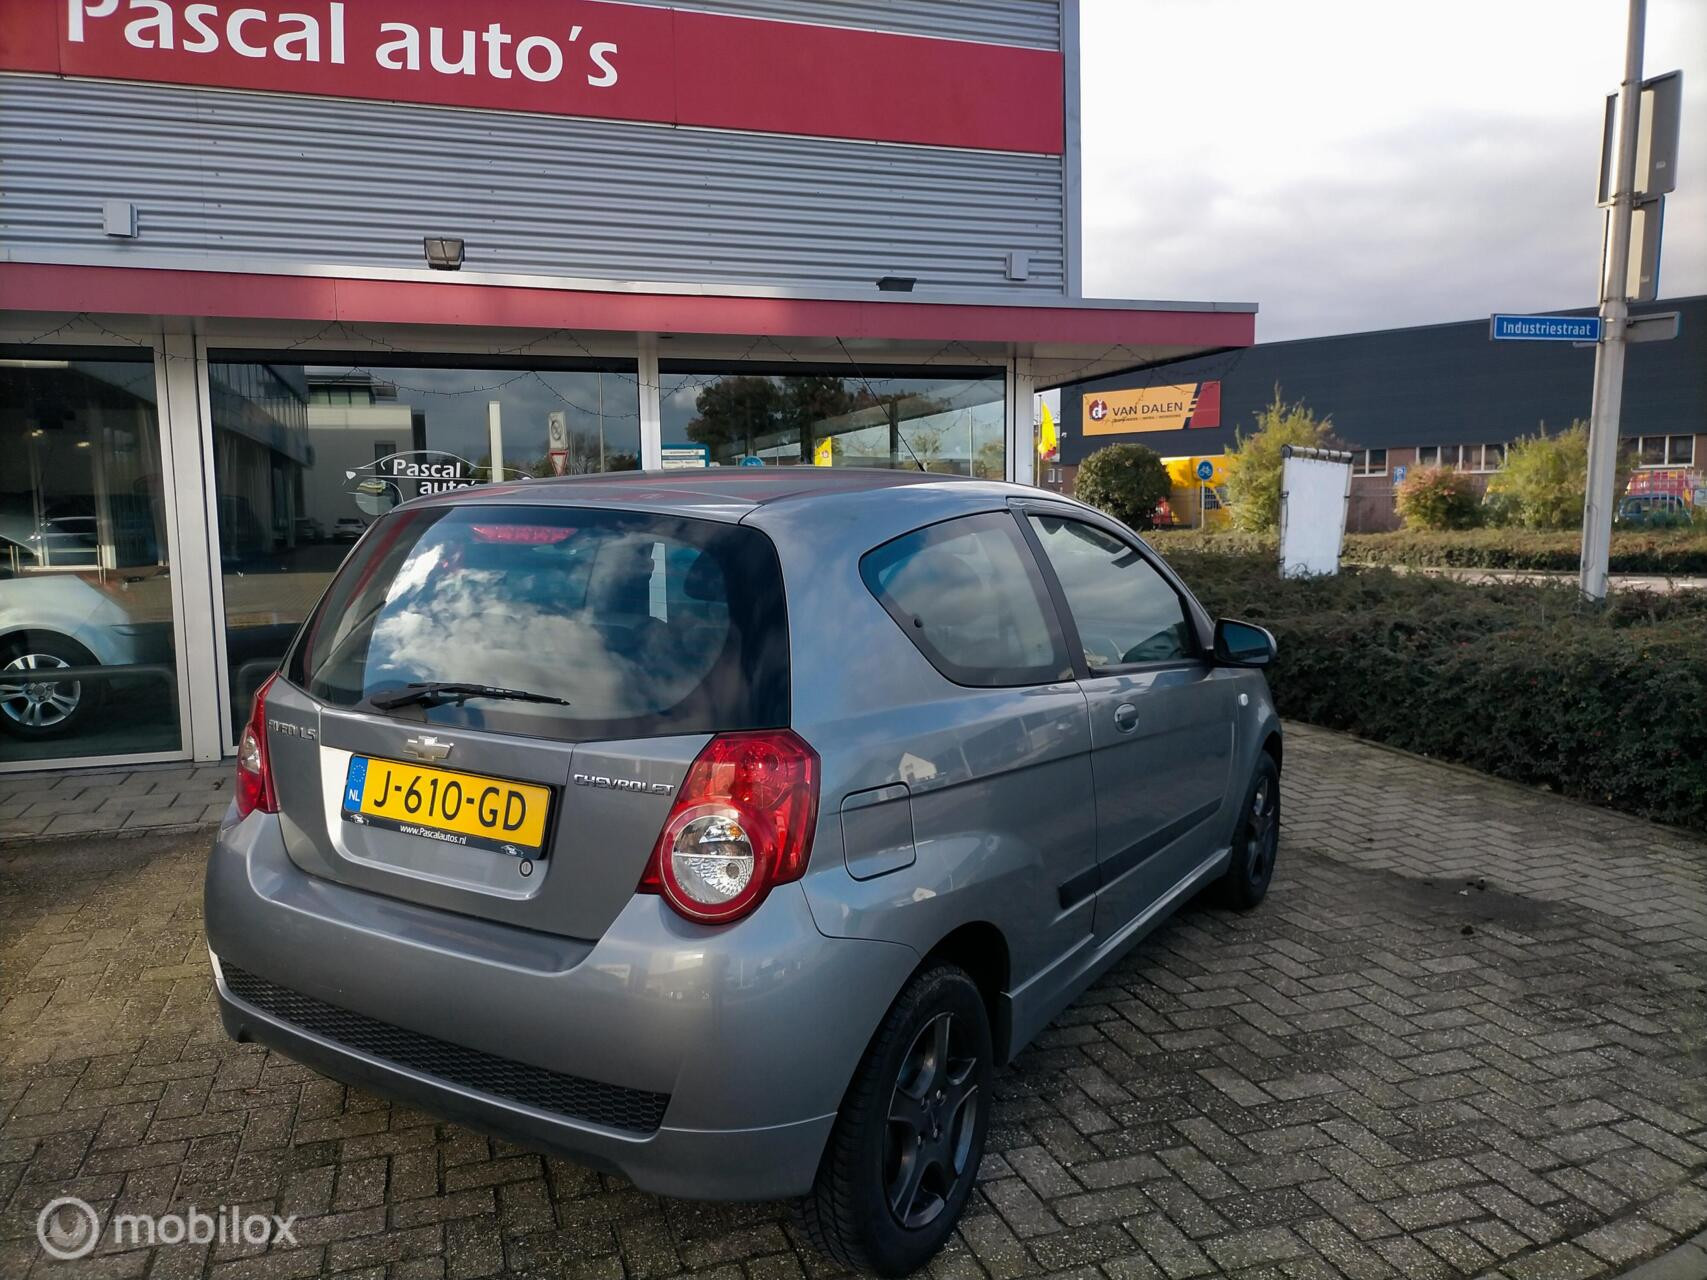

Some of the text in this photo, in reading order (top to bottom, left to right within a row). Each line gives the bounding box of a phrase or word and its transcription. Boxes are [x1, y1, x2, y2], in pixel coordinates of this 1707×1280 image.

[68, 0, 618, 88] Pascal auto's
[1503, 321, 1592, 336] Industriestraat
[1112, 401, 1183, 417] VAN DALEN
[393, 459, 461, 478] Pascal
[349, 788, 361, 802] NL
[574, 774, 676, 797] CHEVROLET
[373, 770, 527, 832] J-610-GD
[400, 824, 467, 846] www.Pascalautos.nl
